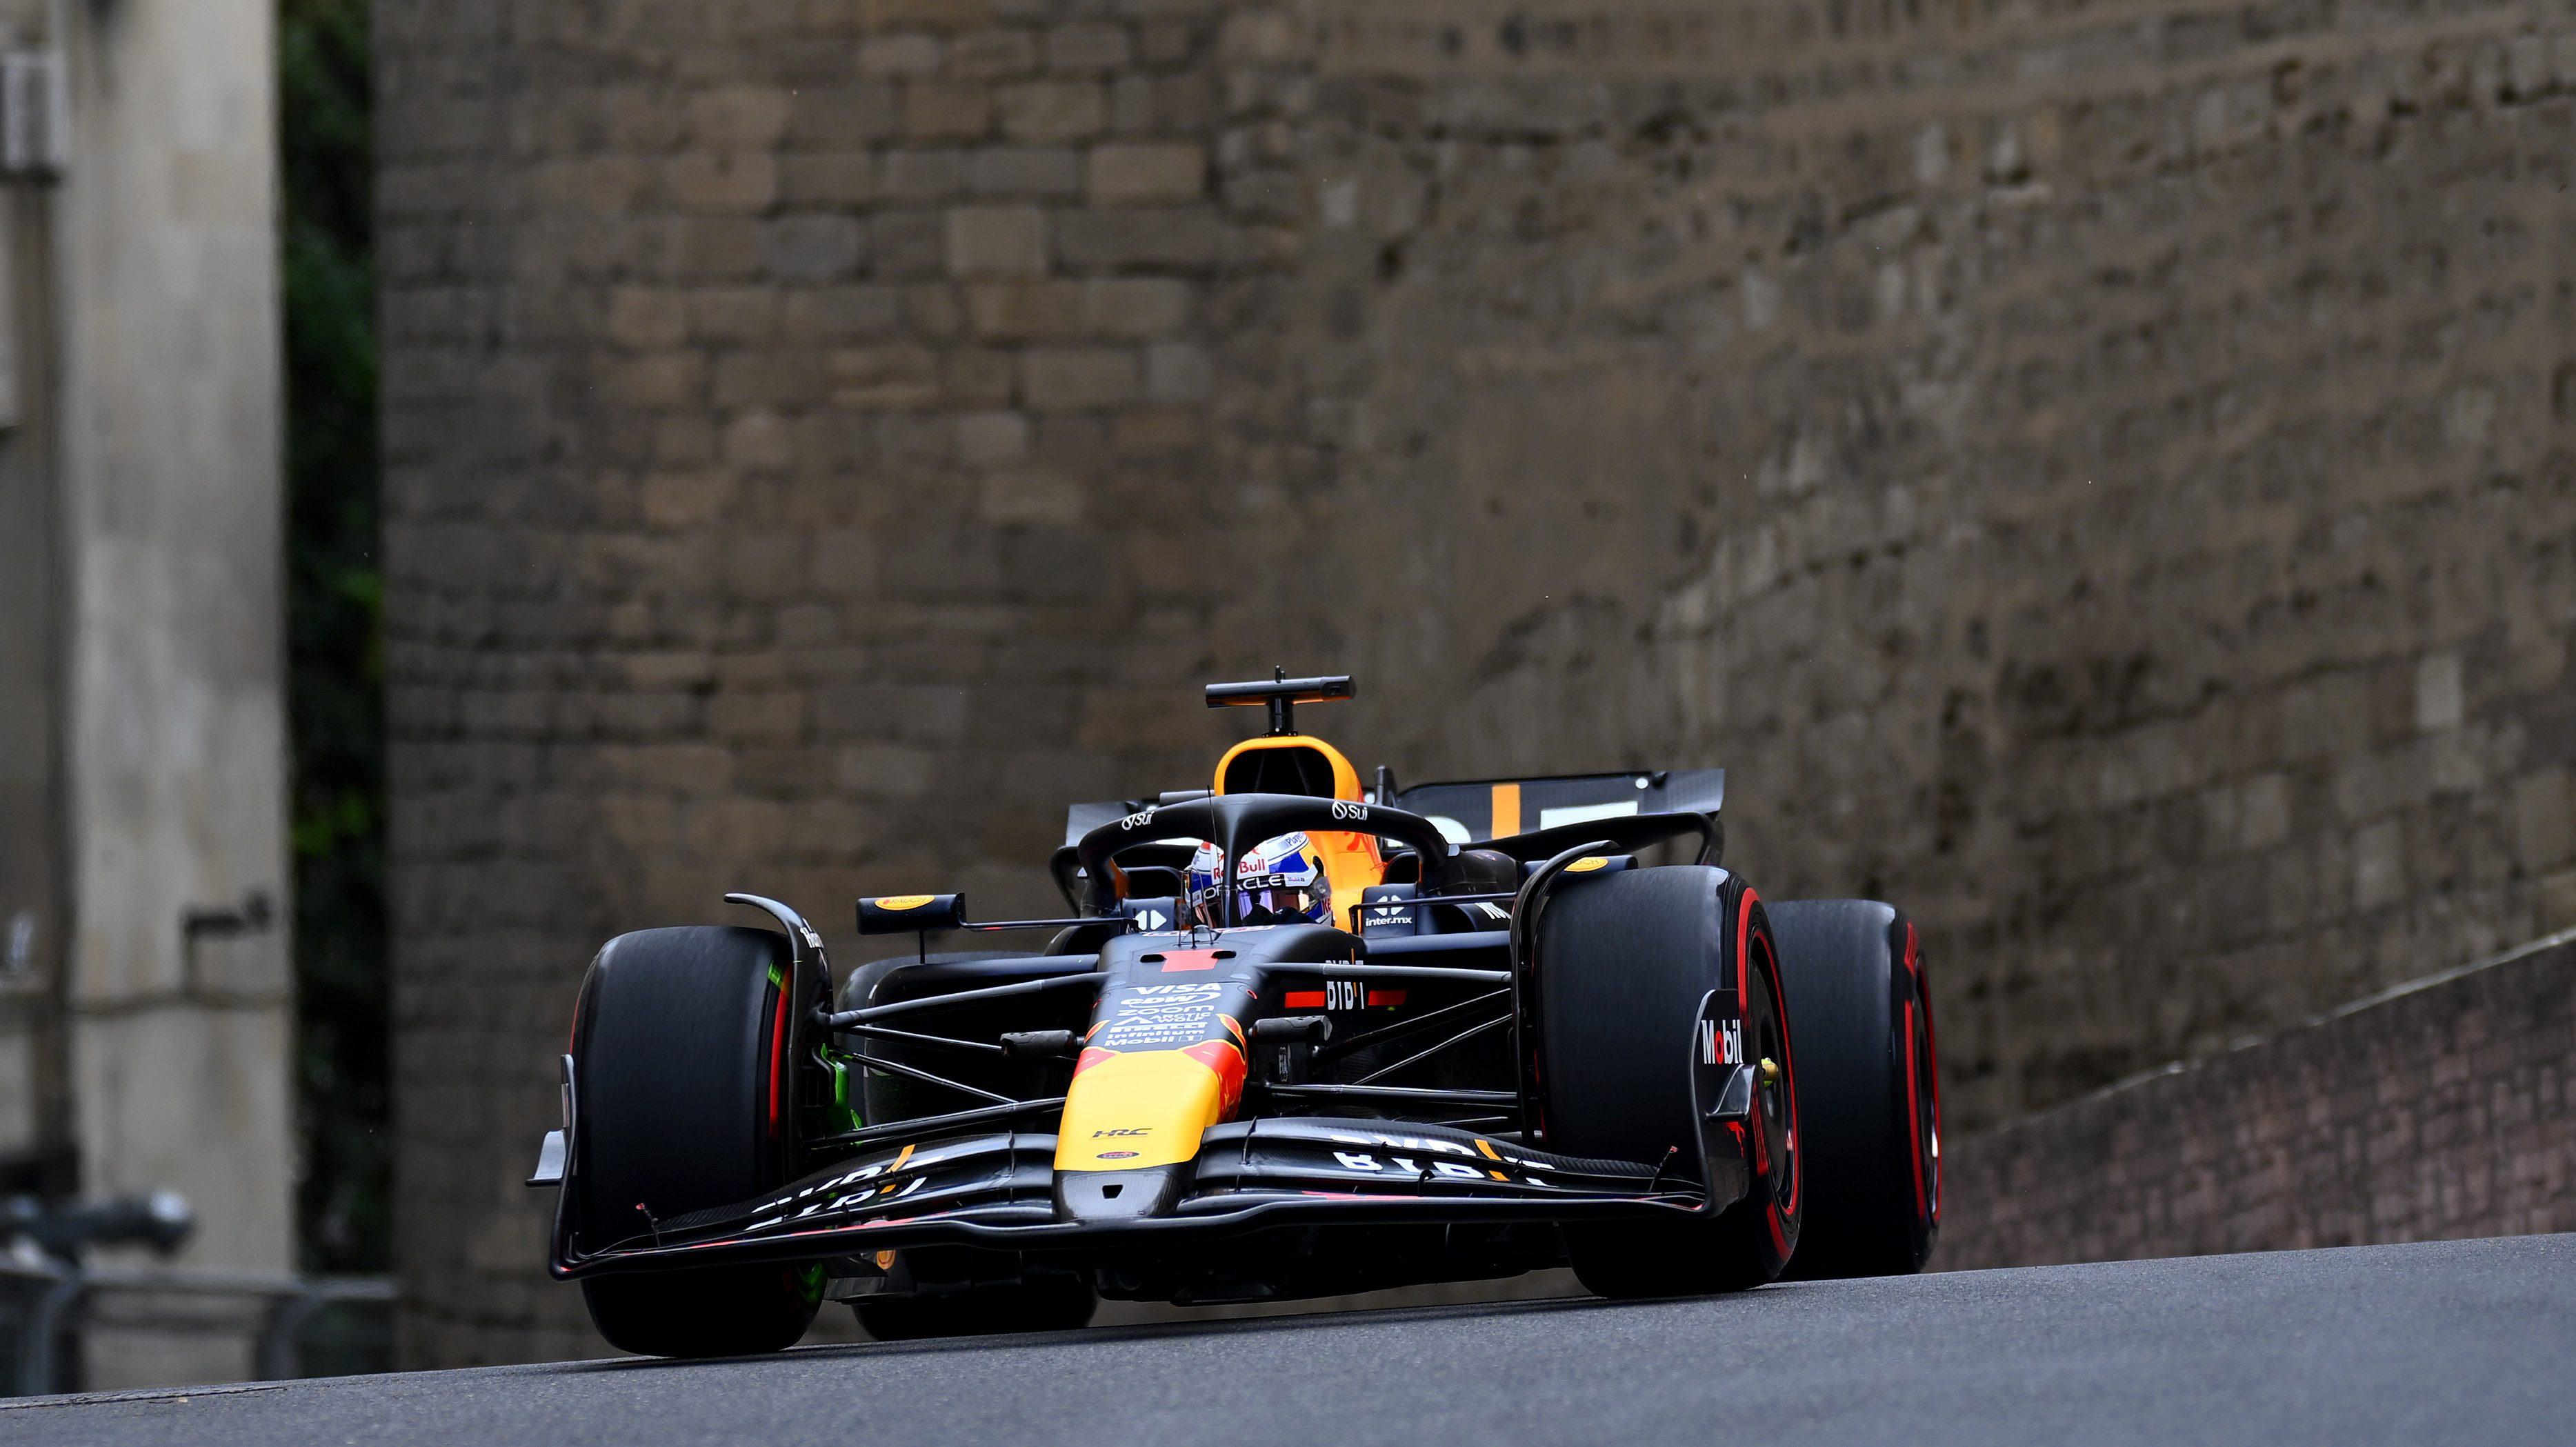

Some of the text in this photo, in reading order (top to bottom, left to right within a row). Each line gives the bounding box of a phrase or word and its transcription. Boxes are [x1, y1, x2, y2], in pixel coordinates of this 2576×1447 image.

[1135, 811, 1153, 826] Sui
[1349, 804, 1368, 821] Sui
[1239, 859, 1266, 874] Bull
[1366, 916, 1412, 927] inter.mx
[1128, 982, 1222, 995] VISA
[1121, 994, 1198, 1006] CDW
[1150, 1012, 1212, 1021] ARCTIC
[1110, 1021, 1208, 1033] PIRELLI
[1105, 1036, 1173, 1046] Mobil
[1701, 1019, 1744, 1065] Mobil
[1092, 1128, 1153, 1138] HRC
